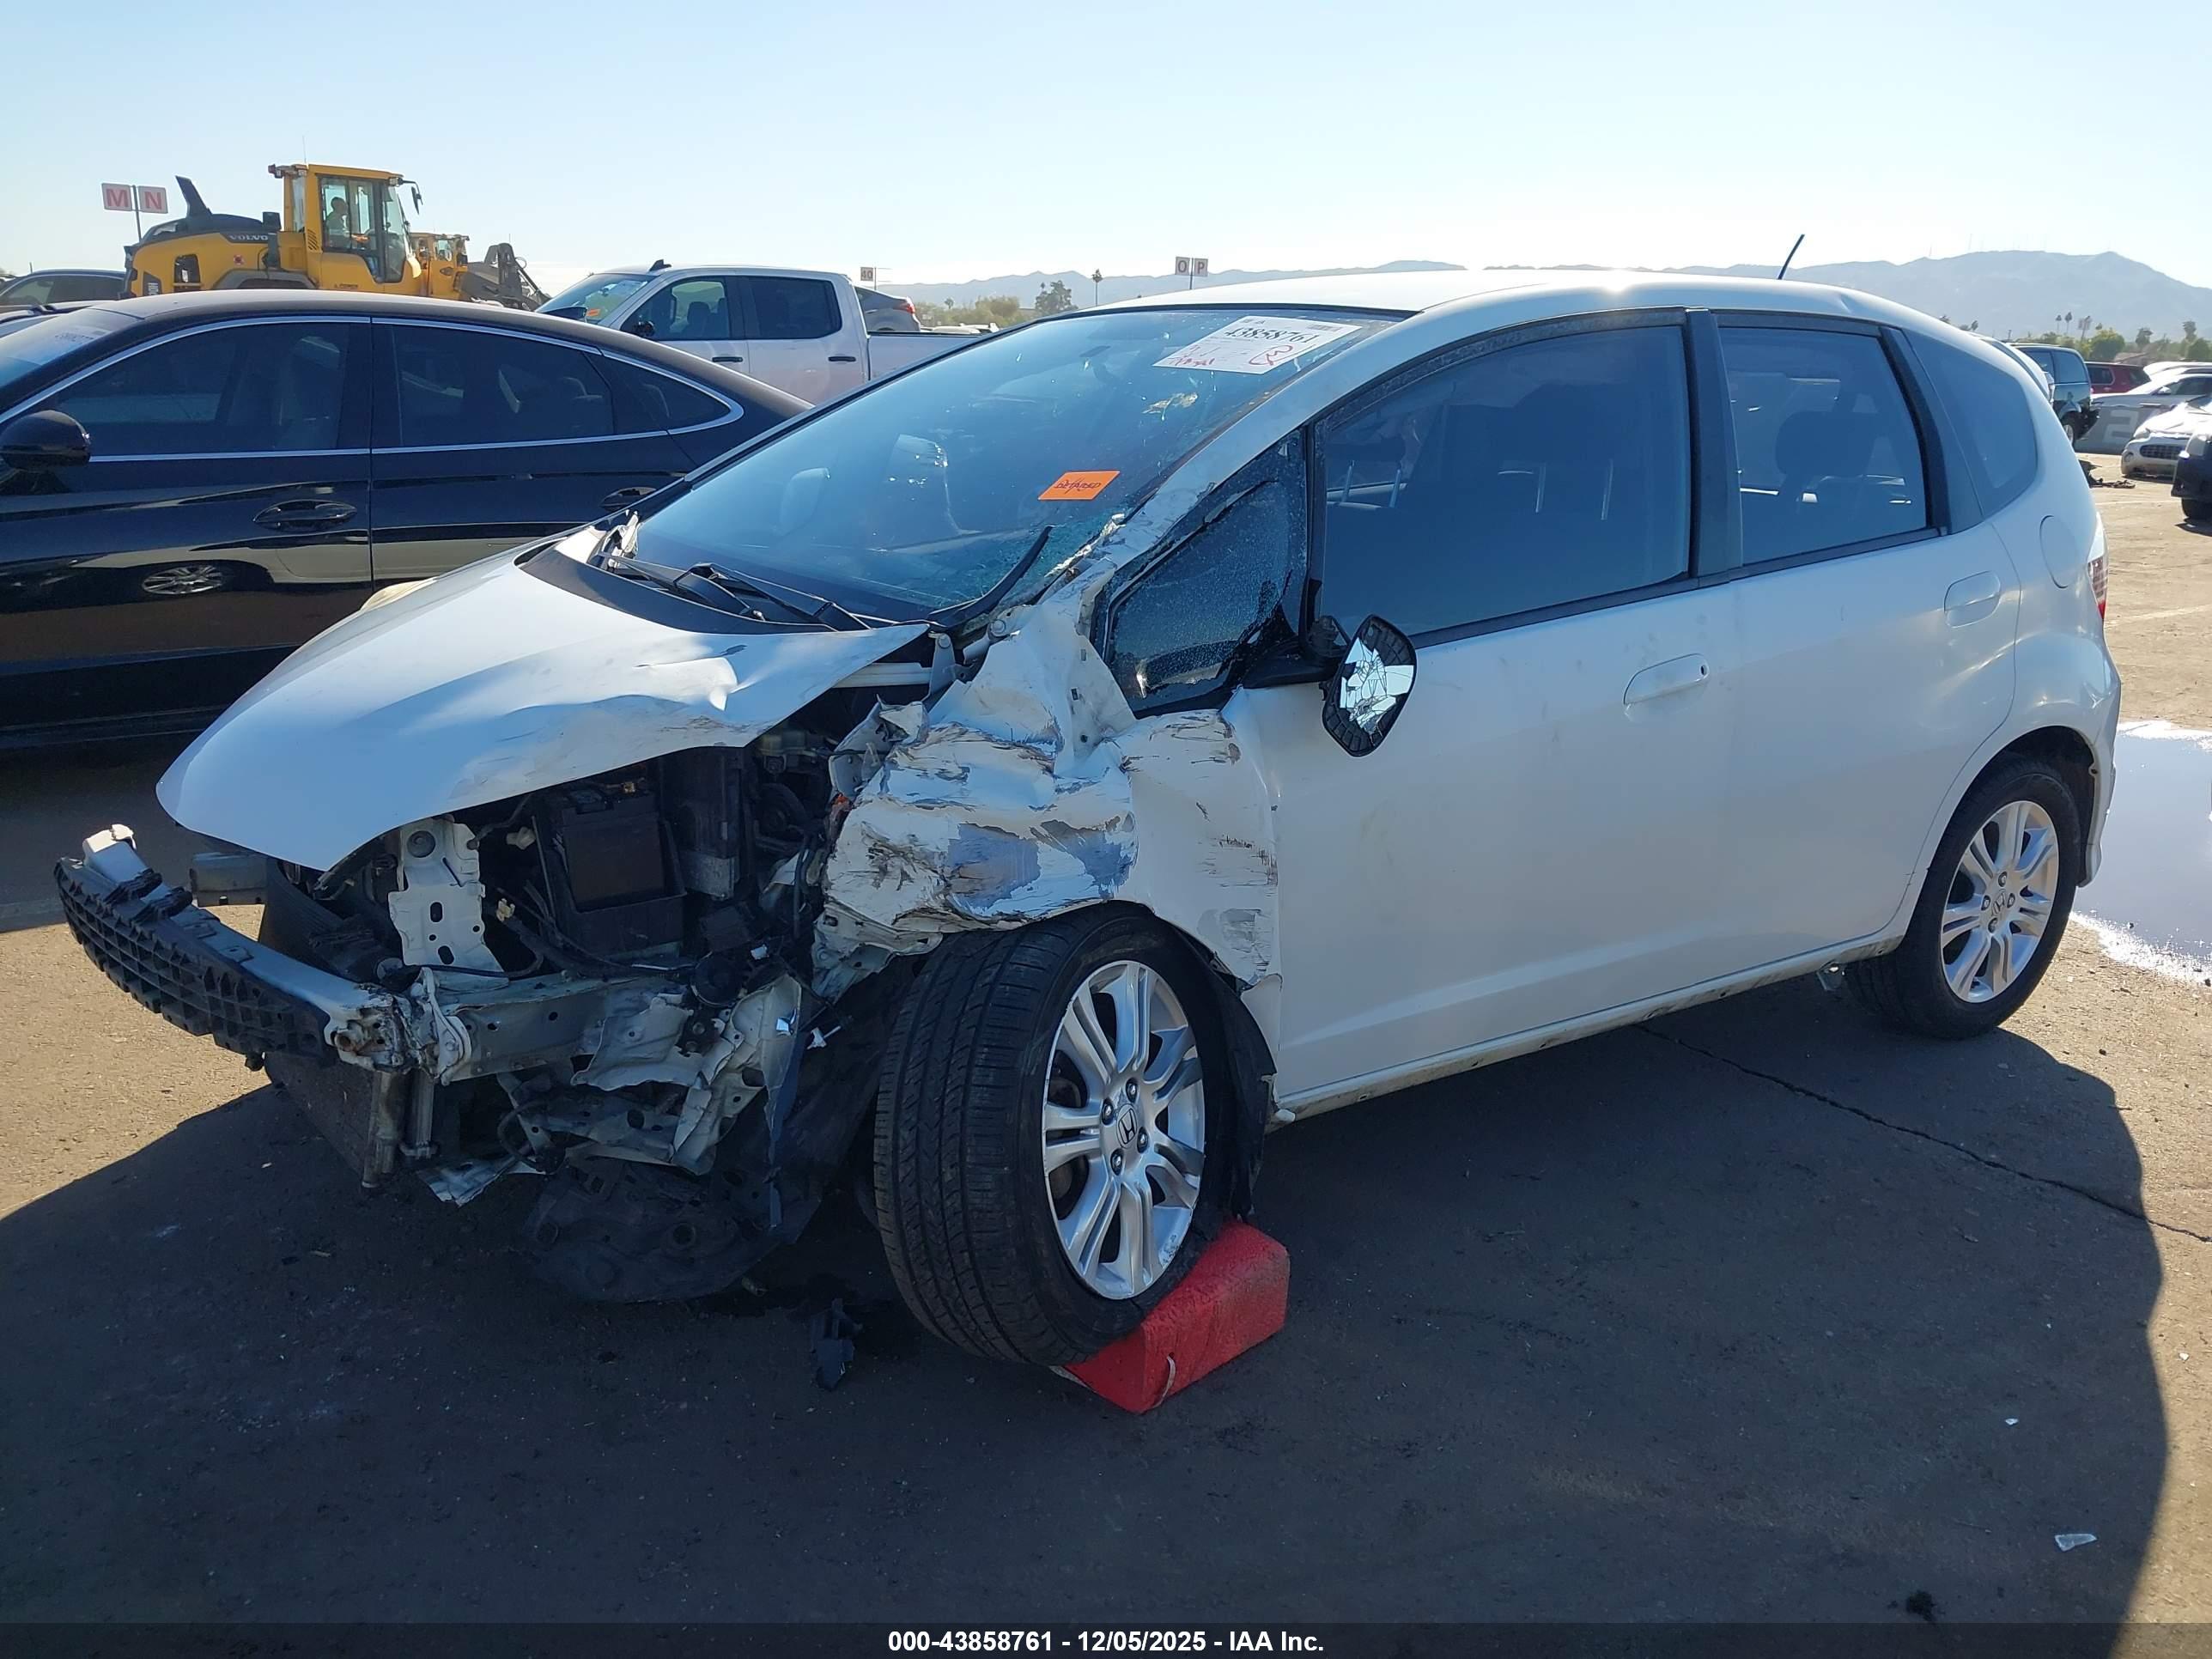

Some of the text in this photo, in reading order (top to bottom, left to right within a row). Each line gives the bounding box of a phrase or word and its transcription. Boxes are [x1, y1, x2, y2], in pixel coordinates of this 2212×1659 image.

[106, 189, 128, 207] M
[144, 191, 162, 210] N
[1198, 261, 1205, 274] P
[1224, 327, 1320, 343] 43858761
